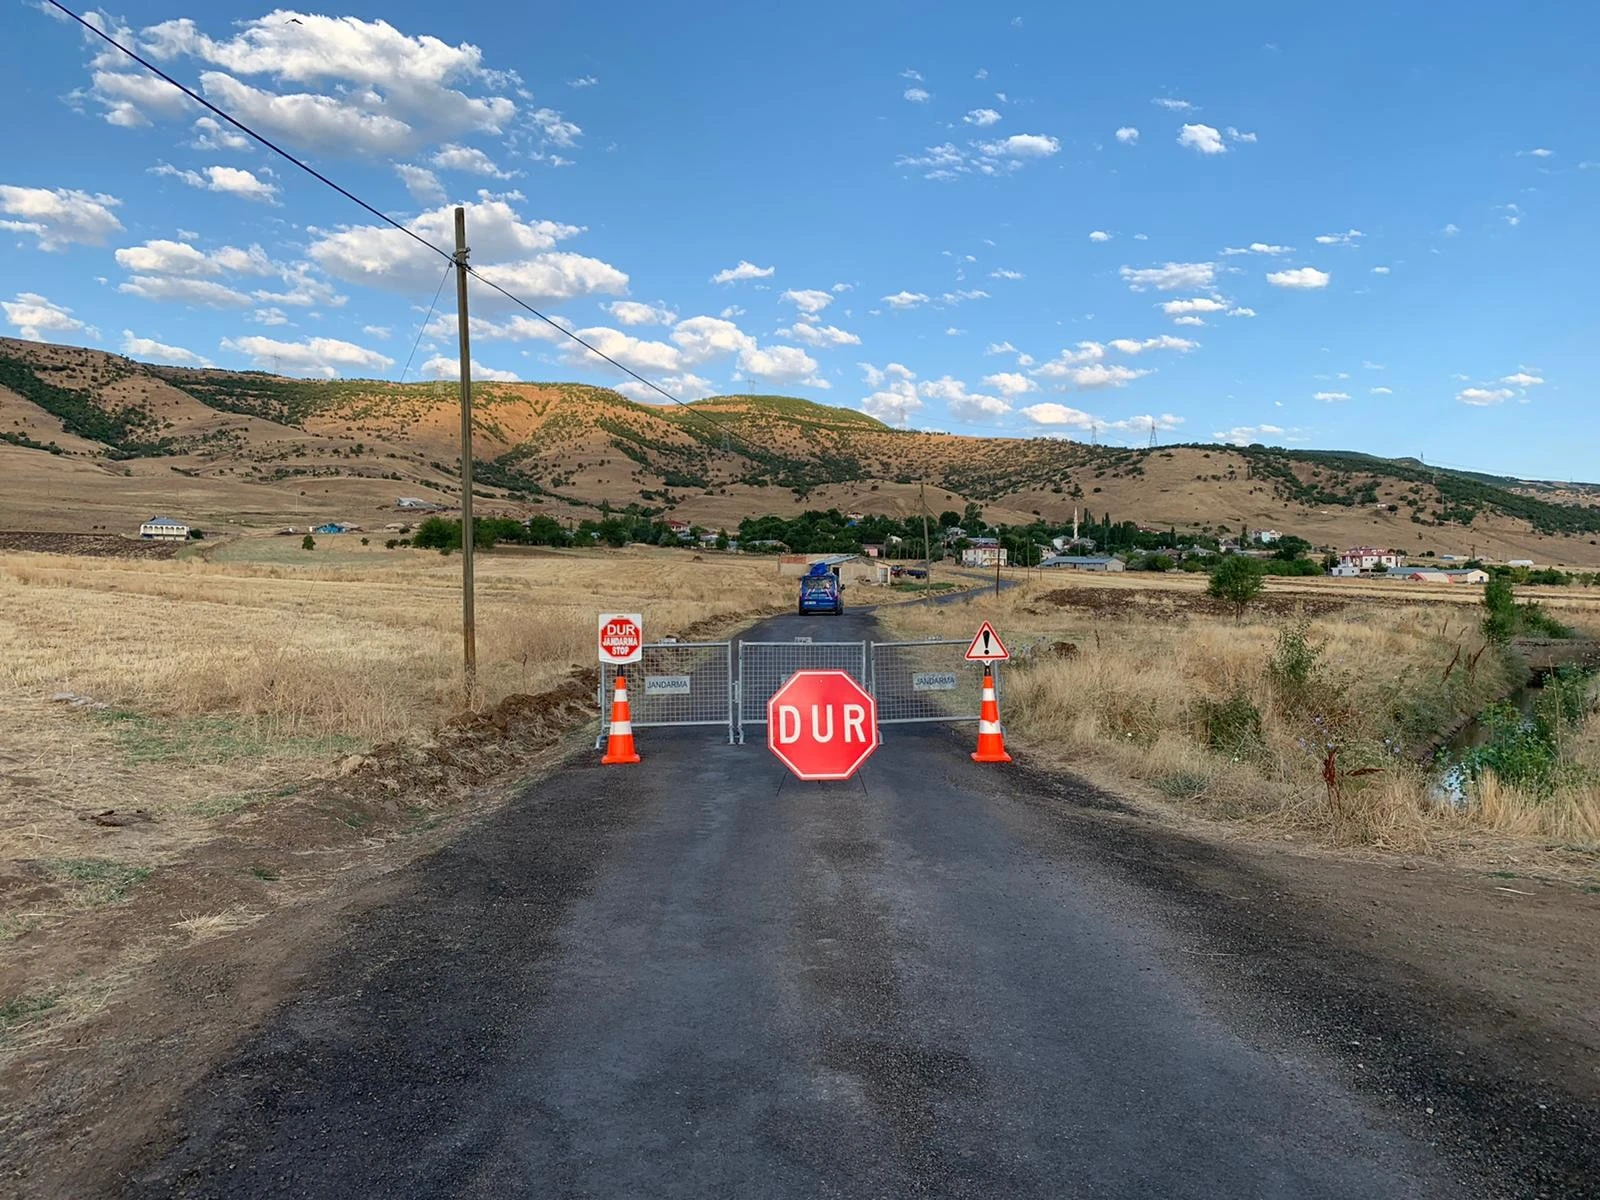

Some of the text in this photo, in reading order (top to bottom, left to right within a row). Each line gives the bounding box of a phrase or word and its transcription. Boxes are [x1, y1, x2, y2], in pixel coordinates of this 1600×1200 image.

[607, 624, 635, 635] DUR
[603, 637, 638, 646] JANDARMA
[612, 647, 629, 655] STOP
[647, 680, 688, 689] JANDARMA
[915, 676, 955, 685] JANDARMA
[779, 704, 866, 744] DUR
